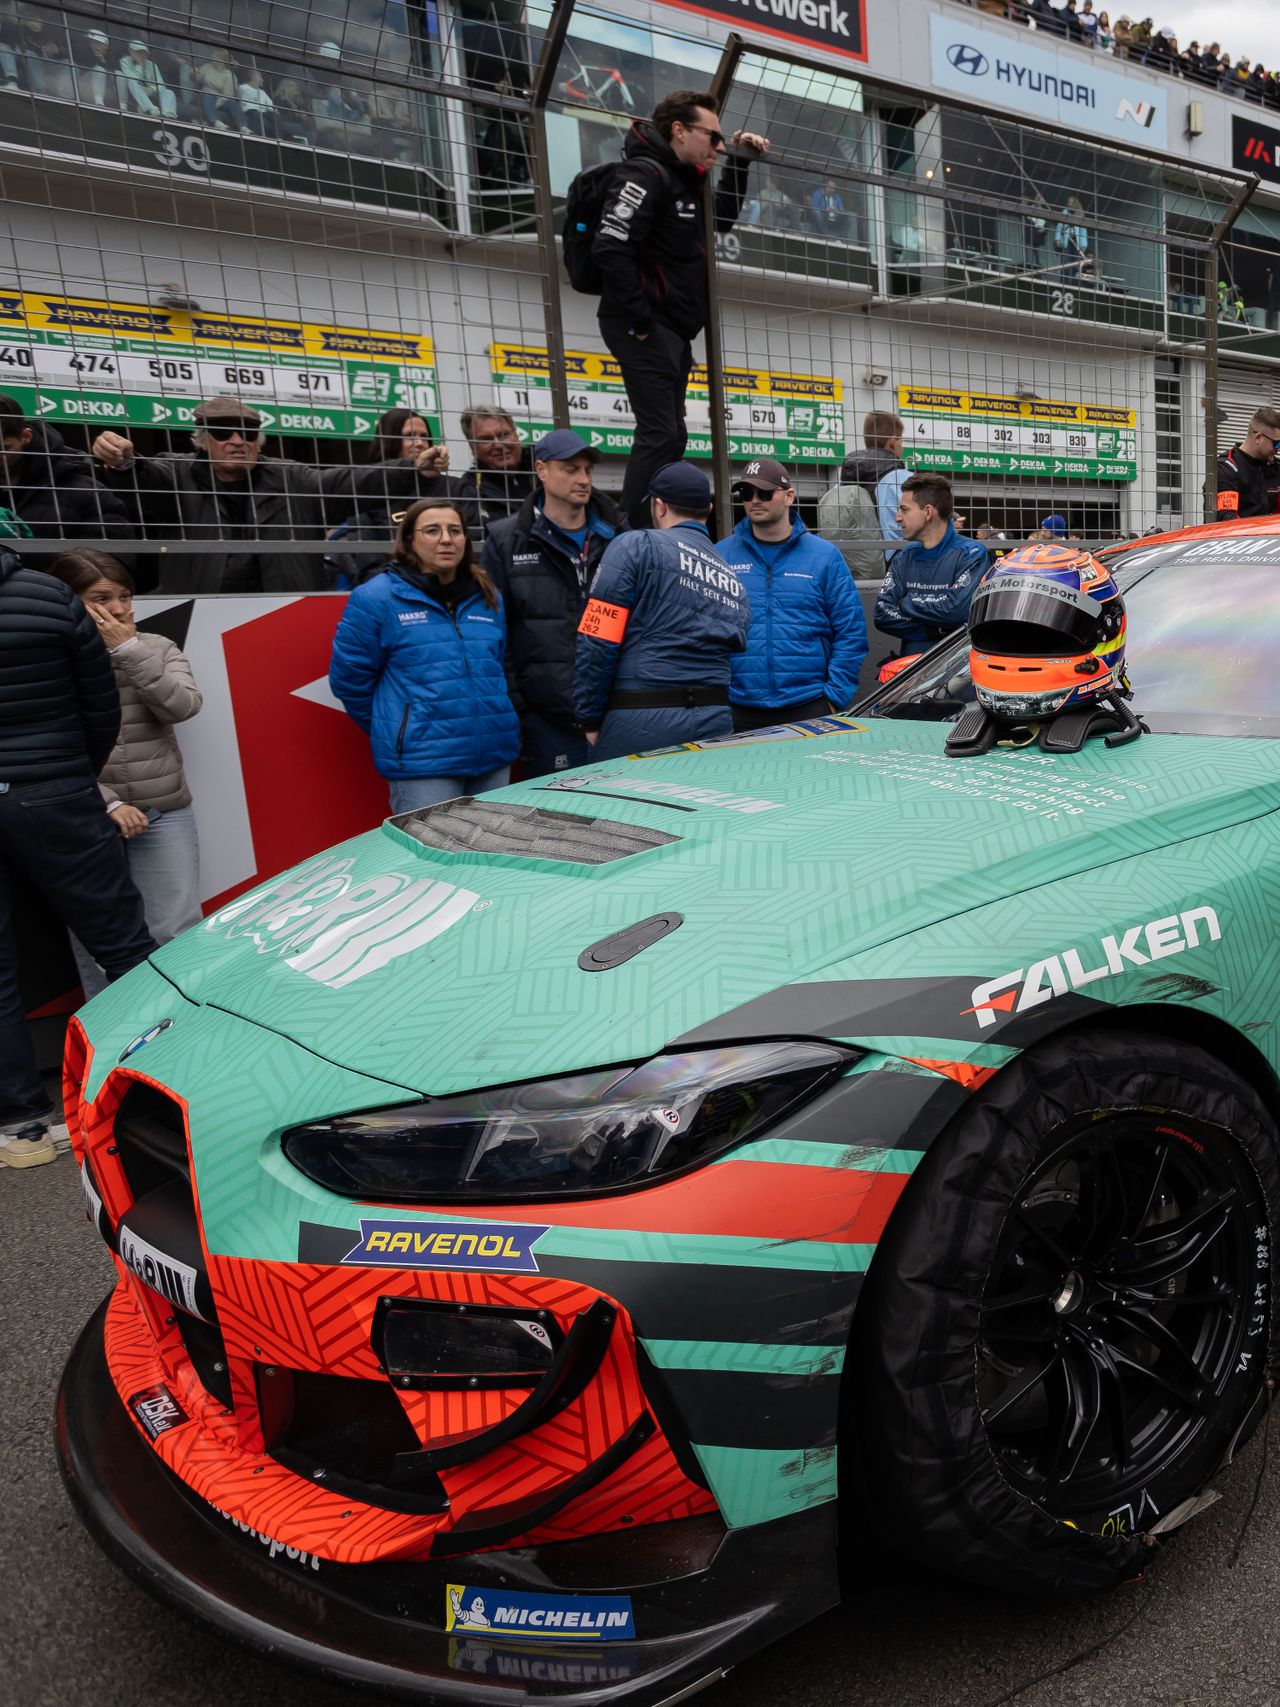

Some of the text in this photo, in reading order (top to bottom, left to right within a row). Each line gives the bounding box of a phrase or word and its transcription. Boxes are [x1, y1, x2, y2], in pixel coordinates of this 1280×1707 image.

[996, 57, 1097, 110] HYUNDAI
[151, 129, 210, 172] 30
[1051, 290, 1075, 315] 28
[56, 308, 165, 330] RAVENOL
[201, 322, 297, 344] RAVENOL
[329, 336, 414, 355] RAVENOL
[69, 354, 116, 375] 474
[148, 360, 193, 380] 505
[224, 367, 265, 386] 669
[298, 373, 330, 392] 971
[774, 380, 829, 393] RAVENOL
[394, 384, 437, 415] 30
[514, 391, 529, 406] 11
[911, 393, 958, 405] RAVENOL
[974, 399, 1018, 411] RAVENOL
[63, 399, 131, 418] DEKRA
[752, 410, 776, 424] 670
[1034, 405, 1074, 416] RAVENOL
[1088, 410, 1128, 421] RAVENOL
[280, 412, 336, 431] DEKRA
[816, 416, 844, 441] 29
[917, 423, 926, 435] 4
[956, 426, 971, 438] 88
[994, 429, 1013, 442] 302
[1032, 432, 1051, 444] 303
[1069, 435, 1087, 447] 830
[686, 438, 713, 452] EKRA
[741, 442, 776, 455] DEKRA
[802, 446, 836, 458] DEKRA
[1116, 440, 1136, 460] 28
[924, 453, 953, 466] DEKRA
[973, 457, 1001, 468] DEKRA
[1020, 459, 1046, 470] DEKRA
[1064, 462, 1090, 473] DEKRA
[1182, 539, 1279, 557] GRAN
[512, 553, 539, 563] HAKRO
[1173, 557, 1200, 565] THE
[679, 552, 740, 598] HAKRO
[703, 586, 721, 602] SEIT
[999, 577, 1079, 604] Motorsport
[398, 610, 427, 622] HAKRO
[976, 769, 1023, 783] move
[1025, 780, 1048, 789] or
[1048, 785, 1108, 809] affect
[979, 761, 1069, 784] something
[1072, 779, 1091, 789] is
[1093, 785, 1126, 802] the
[929, 780, 987, 798] ability
[988, 792, 1010, 803] to
[1011, 796, 1038, 811] do
[1039, 808, 1060, 822] it.
[963, 776, 987, 787] do
[988, 783, 1085, 816] something
[960, 905, 1222, 1029] FALKEN
[364, 1229, 523, 1258] RAVENOL
[141, 1394, 180, 1424] DSK
[493, 1605, 629, 1628] MICHELIN
